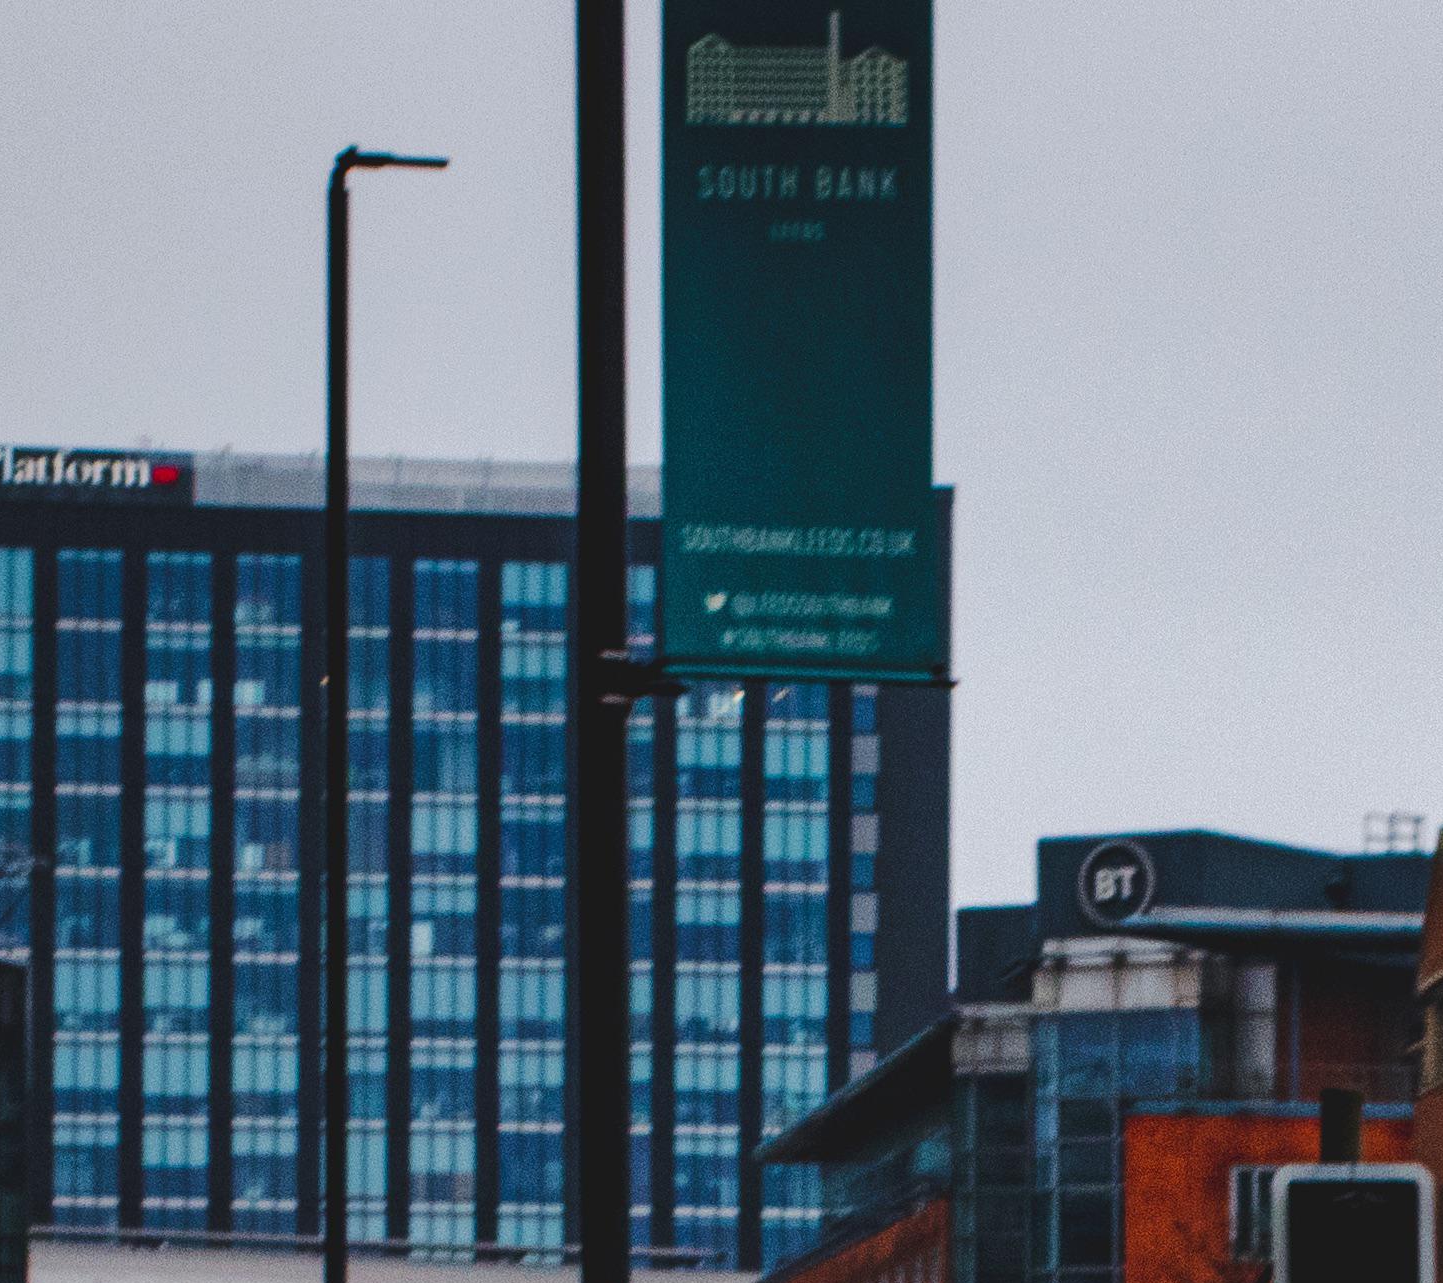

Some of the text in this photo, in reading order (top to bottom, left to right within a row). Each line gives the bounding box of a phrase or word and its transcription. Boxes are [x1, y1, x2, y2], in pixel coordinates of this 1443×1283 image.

[697, 165, 898, 200] SOUTH BANK
[1096, 866, 1136, 902] BT
